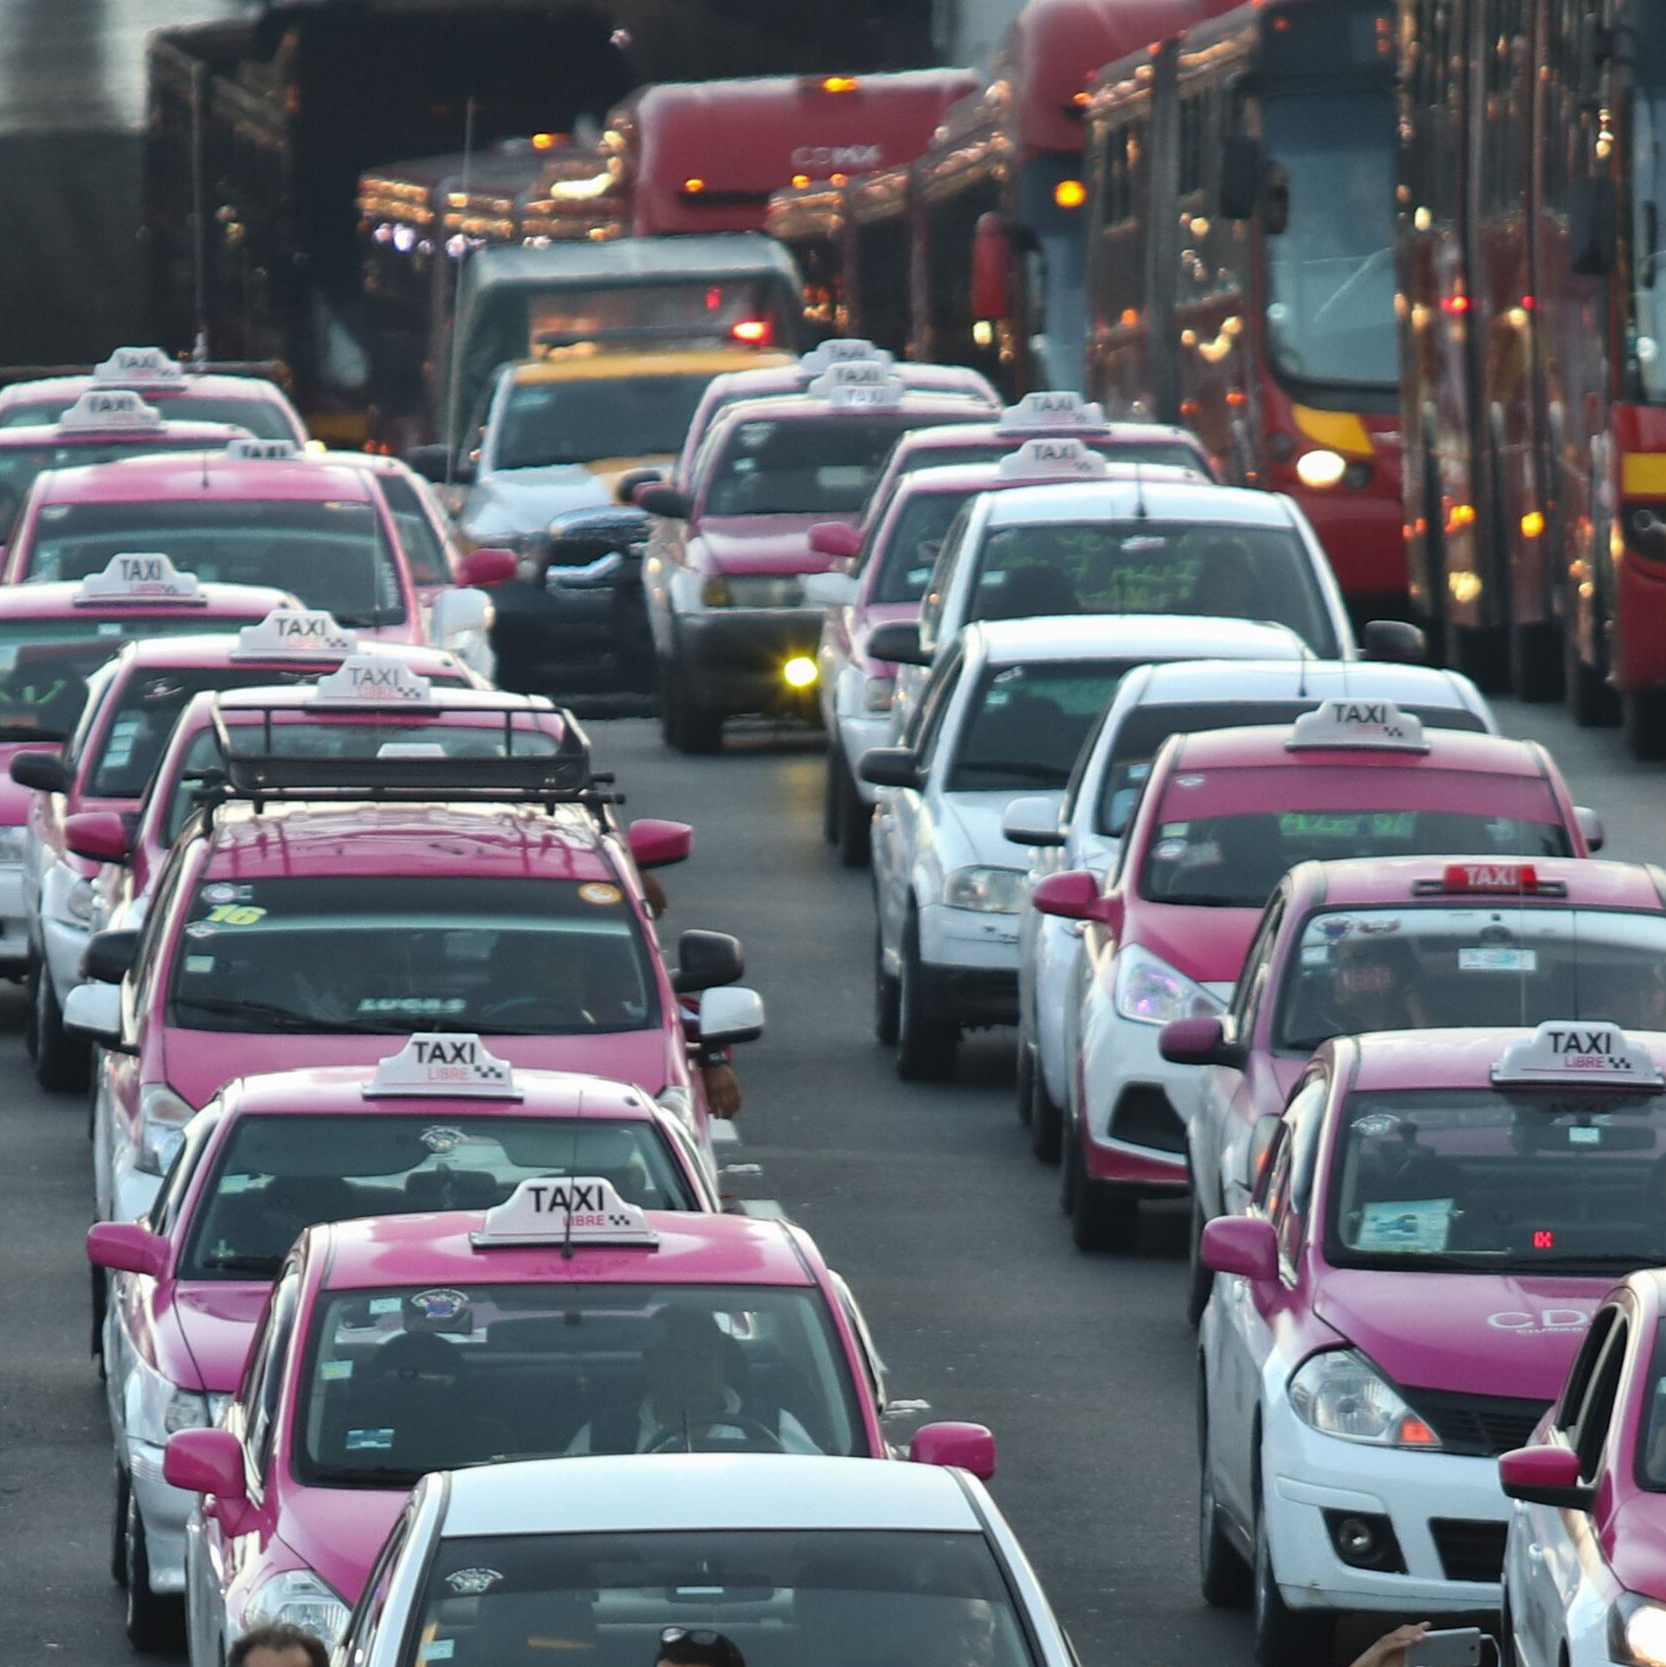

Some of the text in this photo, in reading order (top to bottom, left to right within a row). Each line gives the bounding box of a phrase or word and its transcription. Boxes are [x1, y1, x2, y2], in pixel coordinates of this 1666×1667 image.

[119, 558, 162, 581] TAXI
[275, 617, 327, 636] TAXI
[349, 667, 400, 686] TAXI
[1331, 703, 1386, 723] TAXI
[1466, 865, 1516, 886] TAXI
[204, 905, 266, 925] 16
[413, 1040, 475, 1065] TAXI
[1546, 1032, 1610, 1055] TAXI
[1564, 1056, 1605, 1068] LIBRE
[428, 1066, 469, 1080] LIBRE
[527, 1185, 604, 1213] TAXI
[1487, 1309, 1593, 1329] CD
